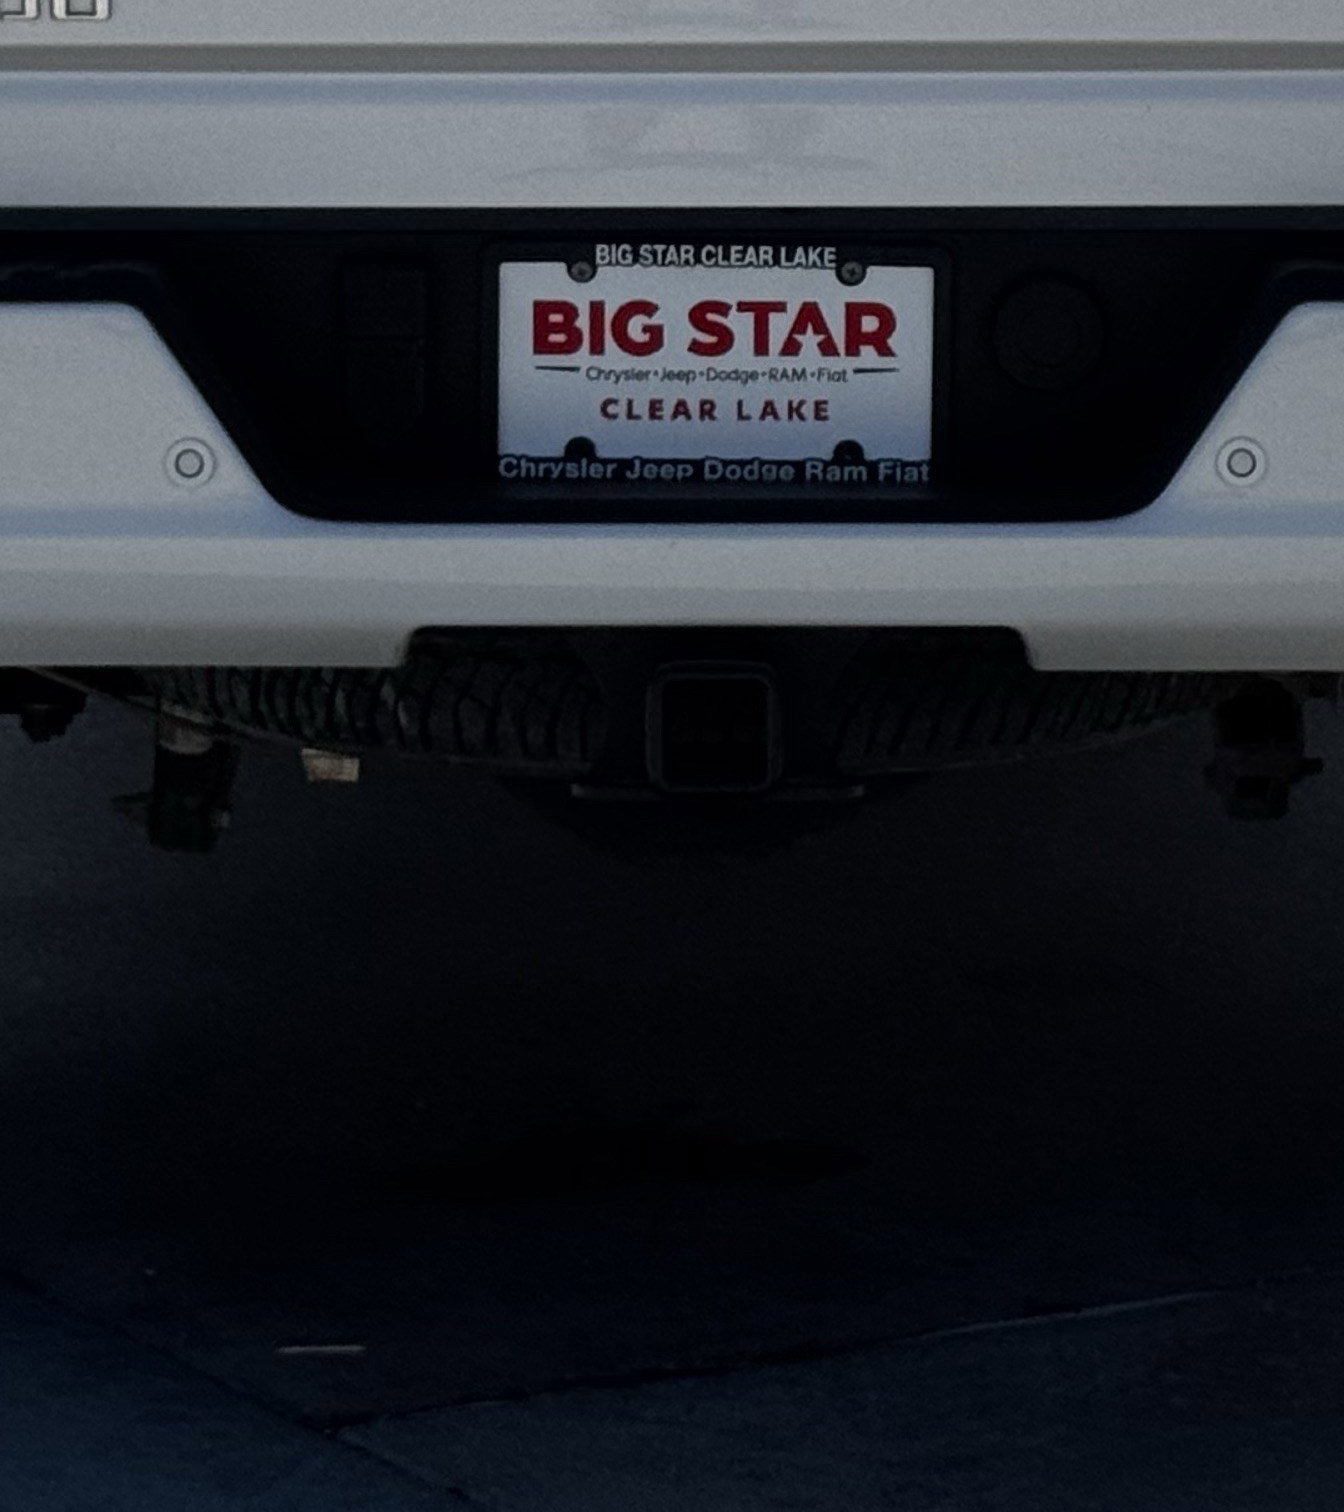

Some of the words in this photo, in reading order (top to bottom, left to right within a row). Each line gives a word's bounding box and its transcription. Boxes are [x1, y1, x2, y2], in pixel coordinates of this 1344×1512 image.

[595, 243, 633, 266] BIG
[638, 243, 695, 266] STAR
[701, 244, 774, 267] CLEAR
[780, 245, 837, 268] LAKE
[532, 299, 665, 357] BIG
[687, 300, 897, 358] STAR
[585, 366, 651, 384] Chrysler
[659, 367, 697, 384] Jeep
[706, 366, 760, 384] Dodge
[768, 367, 807, 382] RAM
[816, 367, 848, 383] Fiat
[600, 398, 718, 421] CLEAR
[736, 399, 830, 422] LAKE
[498, 456, 617, 484] Chrysler
[625, 457, 694, 483] Jeep
[703, 458, 795, 483] Dodge
[805, 460, 868, 483] Ram
[877, 461, 931, 483] Fiat
